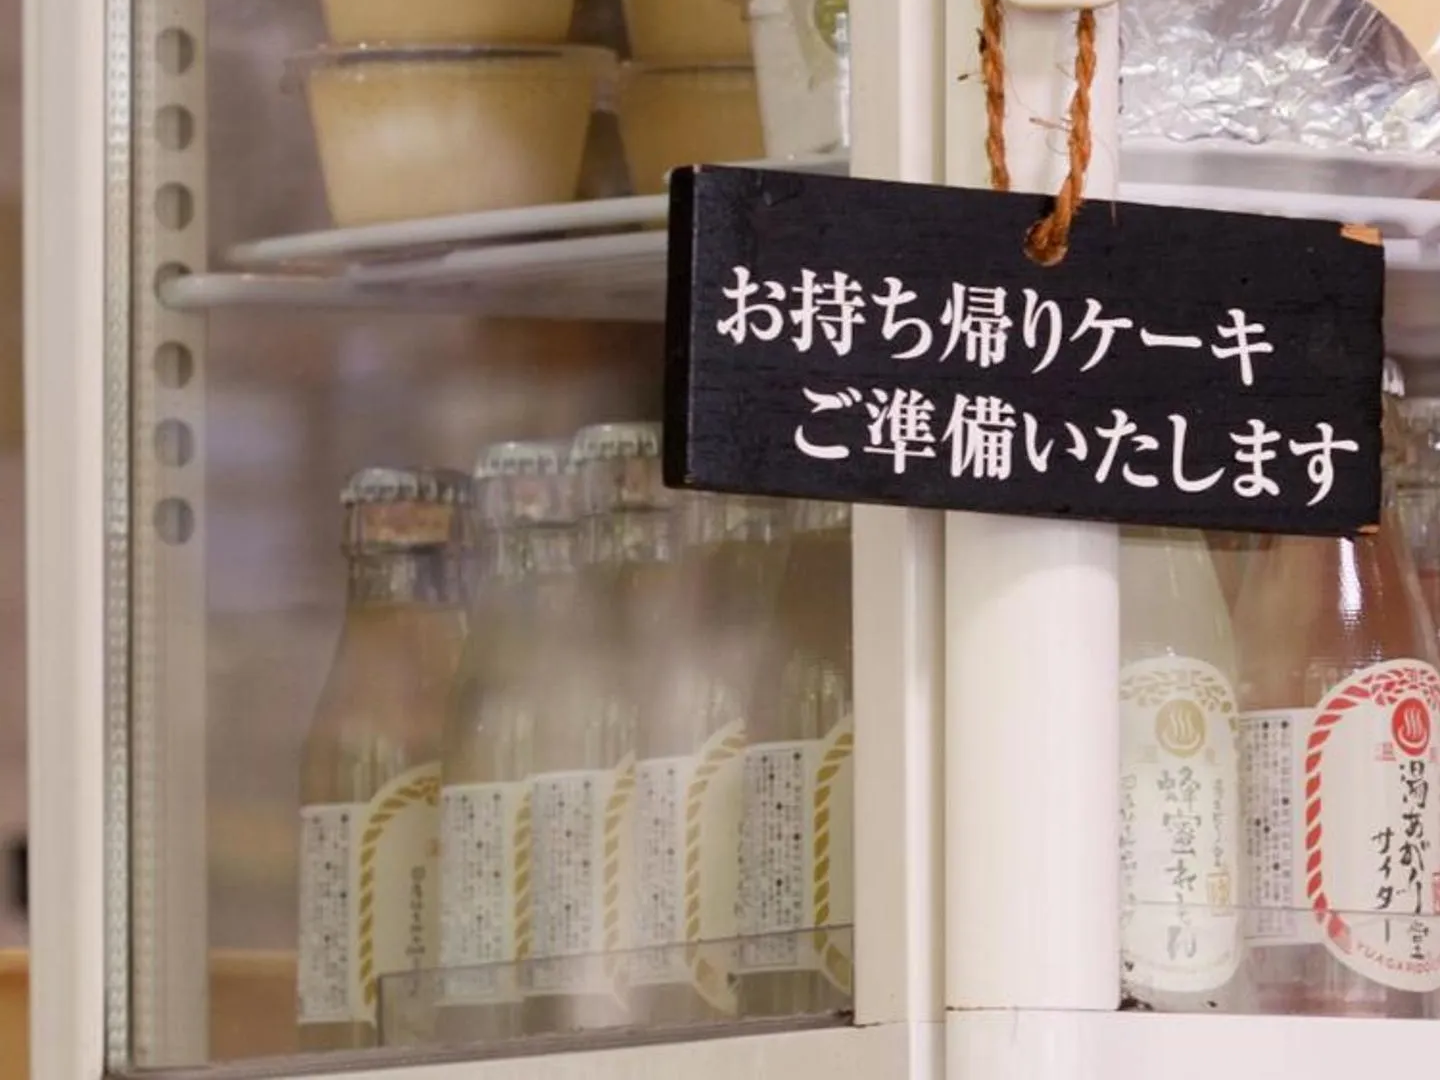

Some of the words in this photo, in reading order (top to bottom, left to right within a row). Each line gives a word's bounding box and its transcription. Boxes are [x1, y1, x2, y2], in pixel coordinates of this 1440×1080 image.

[716, 265, 1276, 387] お持ち帰りケーキ
[794, 385, 1361, 507] ご準備いたします
[1371, 826, 1405, 943] サイダー
